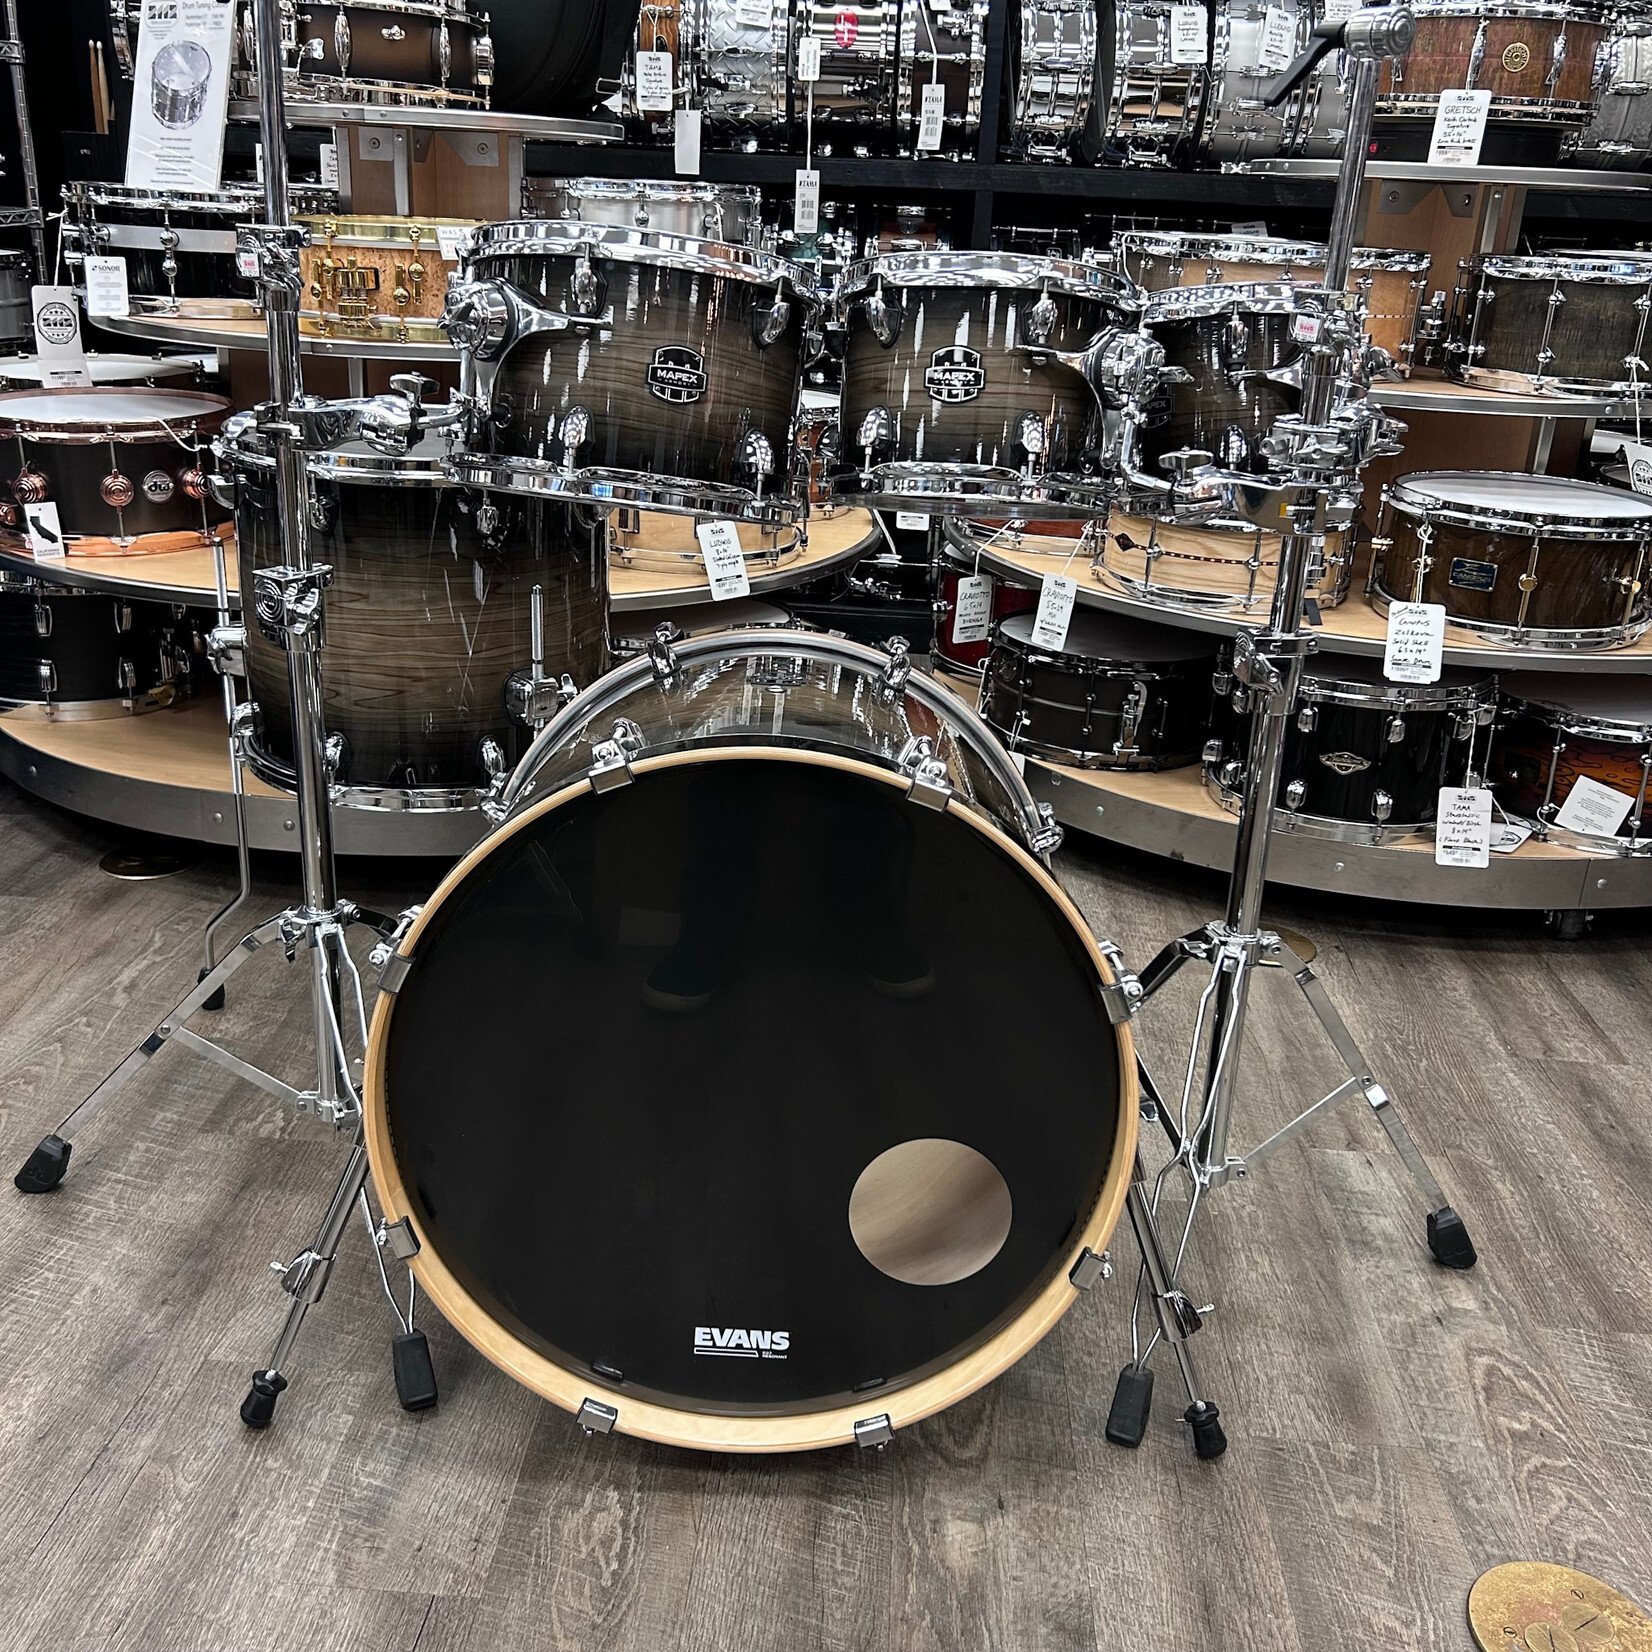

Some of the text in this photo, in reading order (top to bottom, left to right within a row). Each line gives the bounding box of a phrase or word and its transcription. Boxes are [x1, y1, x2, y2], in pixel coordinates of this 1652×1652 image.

[182, 2, 196, 10] Drum
[196, 2, 211, 11] Tuning
[1444, 105, 1482, 115] GRETSCH
[657, 368, 698, 384] MAPEX
[933, 371, 976, 381] MAPEX
[147, 481, 171, 493] dw
[709, 538, 732, 548] LUDWIG
[1042, 586, 1074, 604] CRAVIOTTO
[1394, 629, 1435, 637] Zelkova
[1392, 638, 1430, 646] Solid Shell
[1413, 657, 1433, 666] Drum
[1452, 803, 1471, 811] TAMA
[694, 1326, 791, 1351] EVANS
